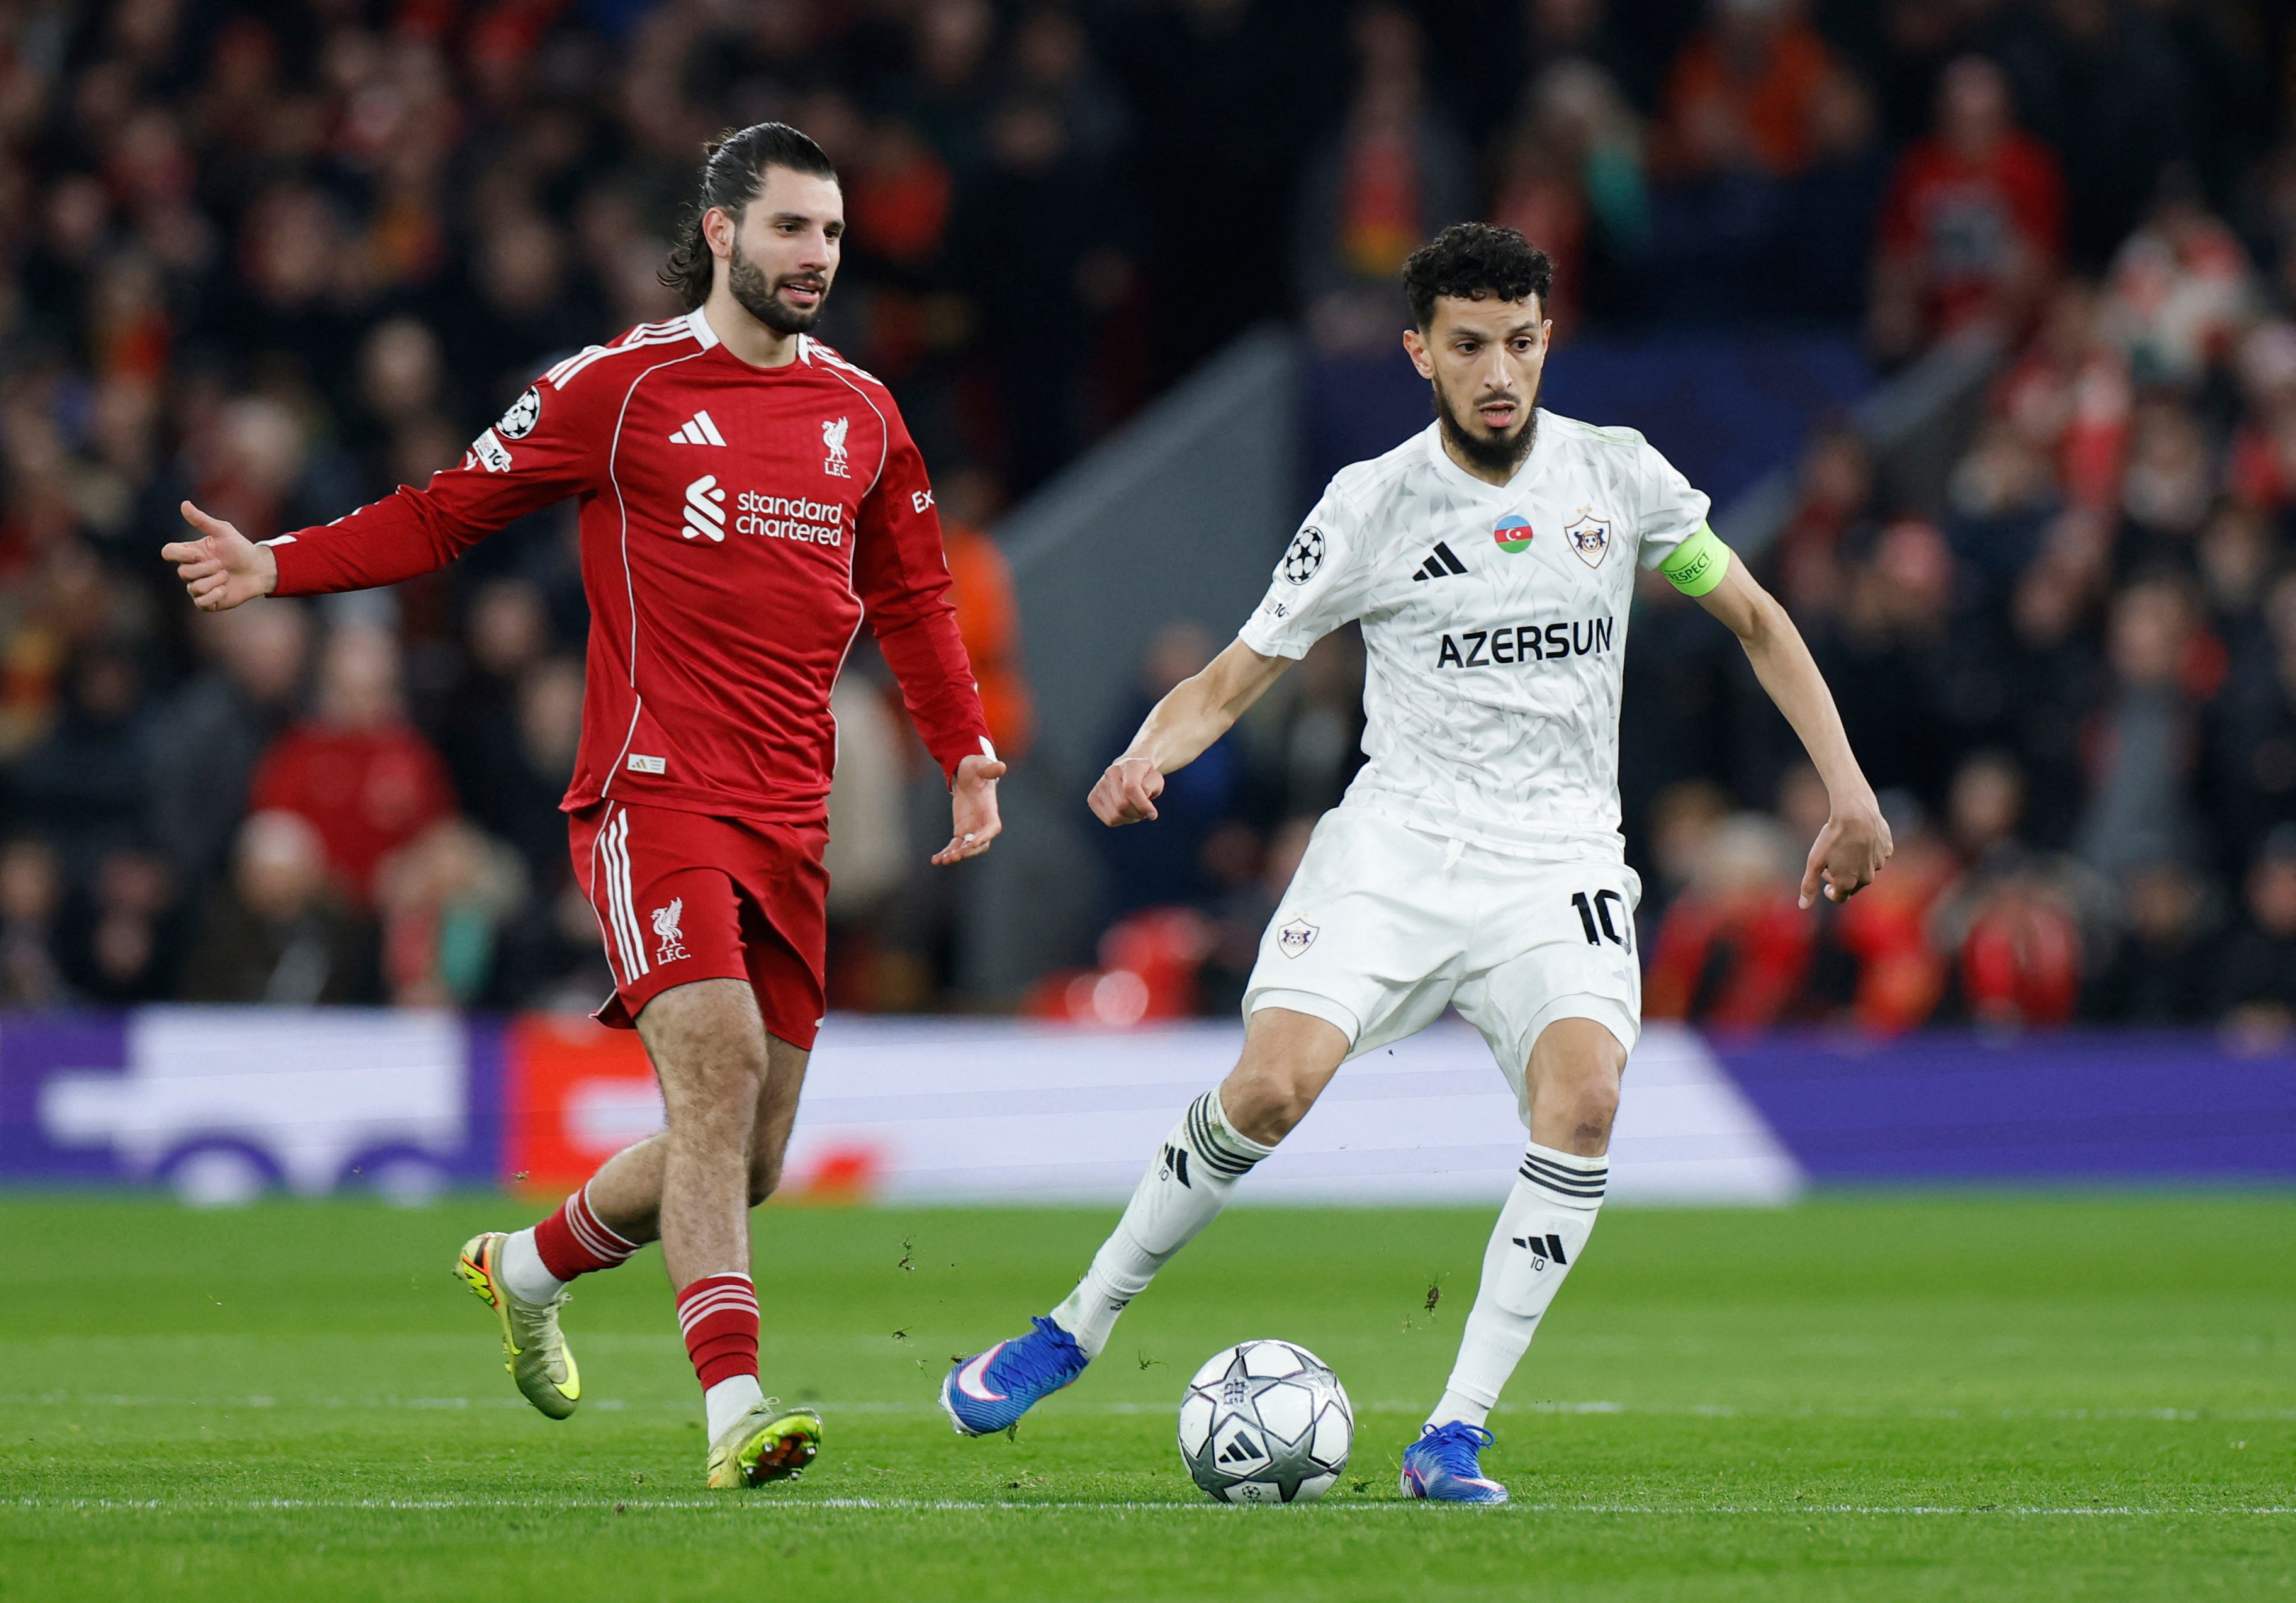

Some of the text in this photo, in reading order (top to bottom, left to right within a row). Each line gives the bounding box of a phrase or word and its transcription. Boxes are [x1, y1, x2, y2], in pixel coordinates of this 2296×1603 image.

[737, 490, 843, 524] standard
[736, 513, 843, 547] chartered
[1437, 616, 1613, 668] AZERSUN
[1571, 889, 1631, 956] 10
[1530, 1256, 1545, 1271] 10
